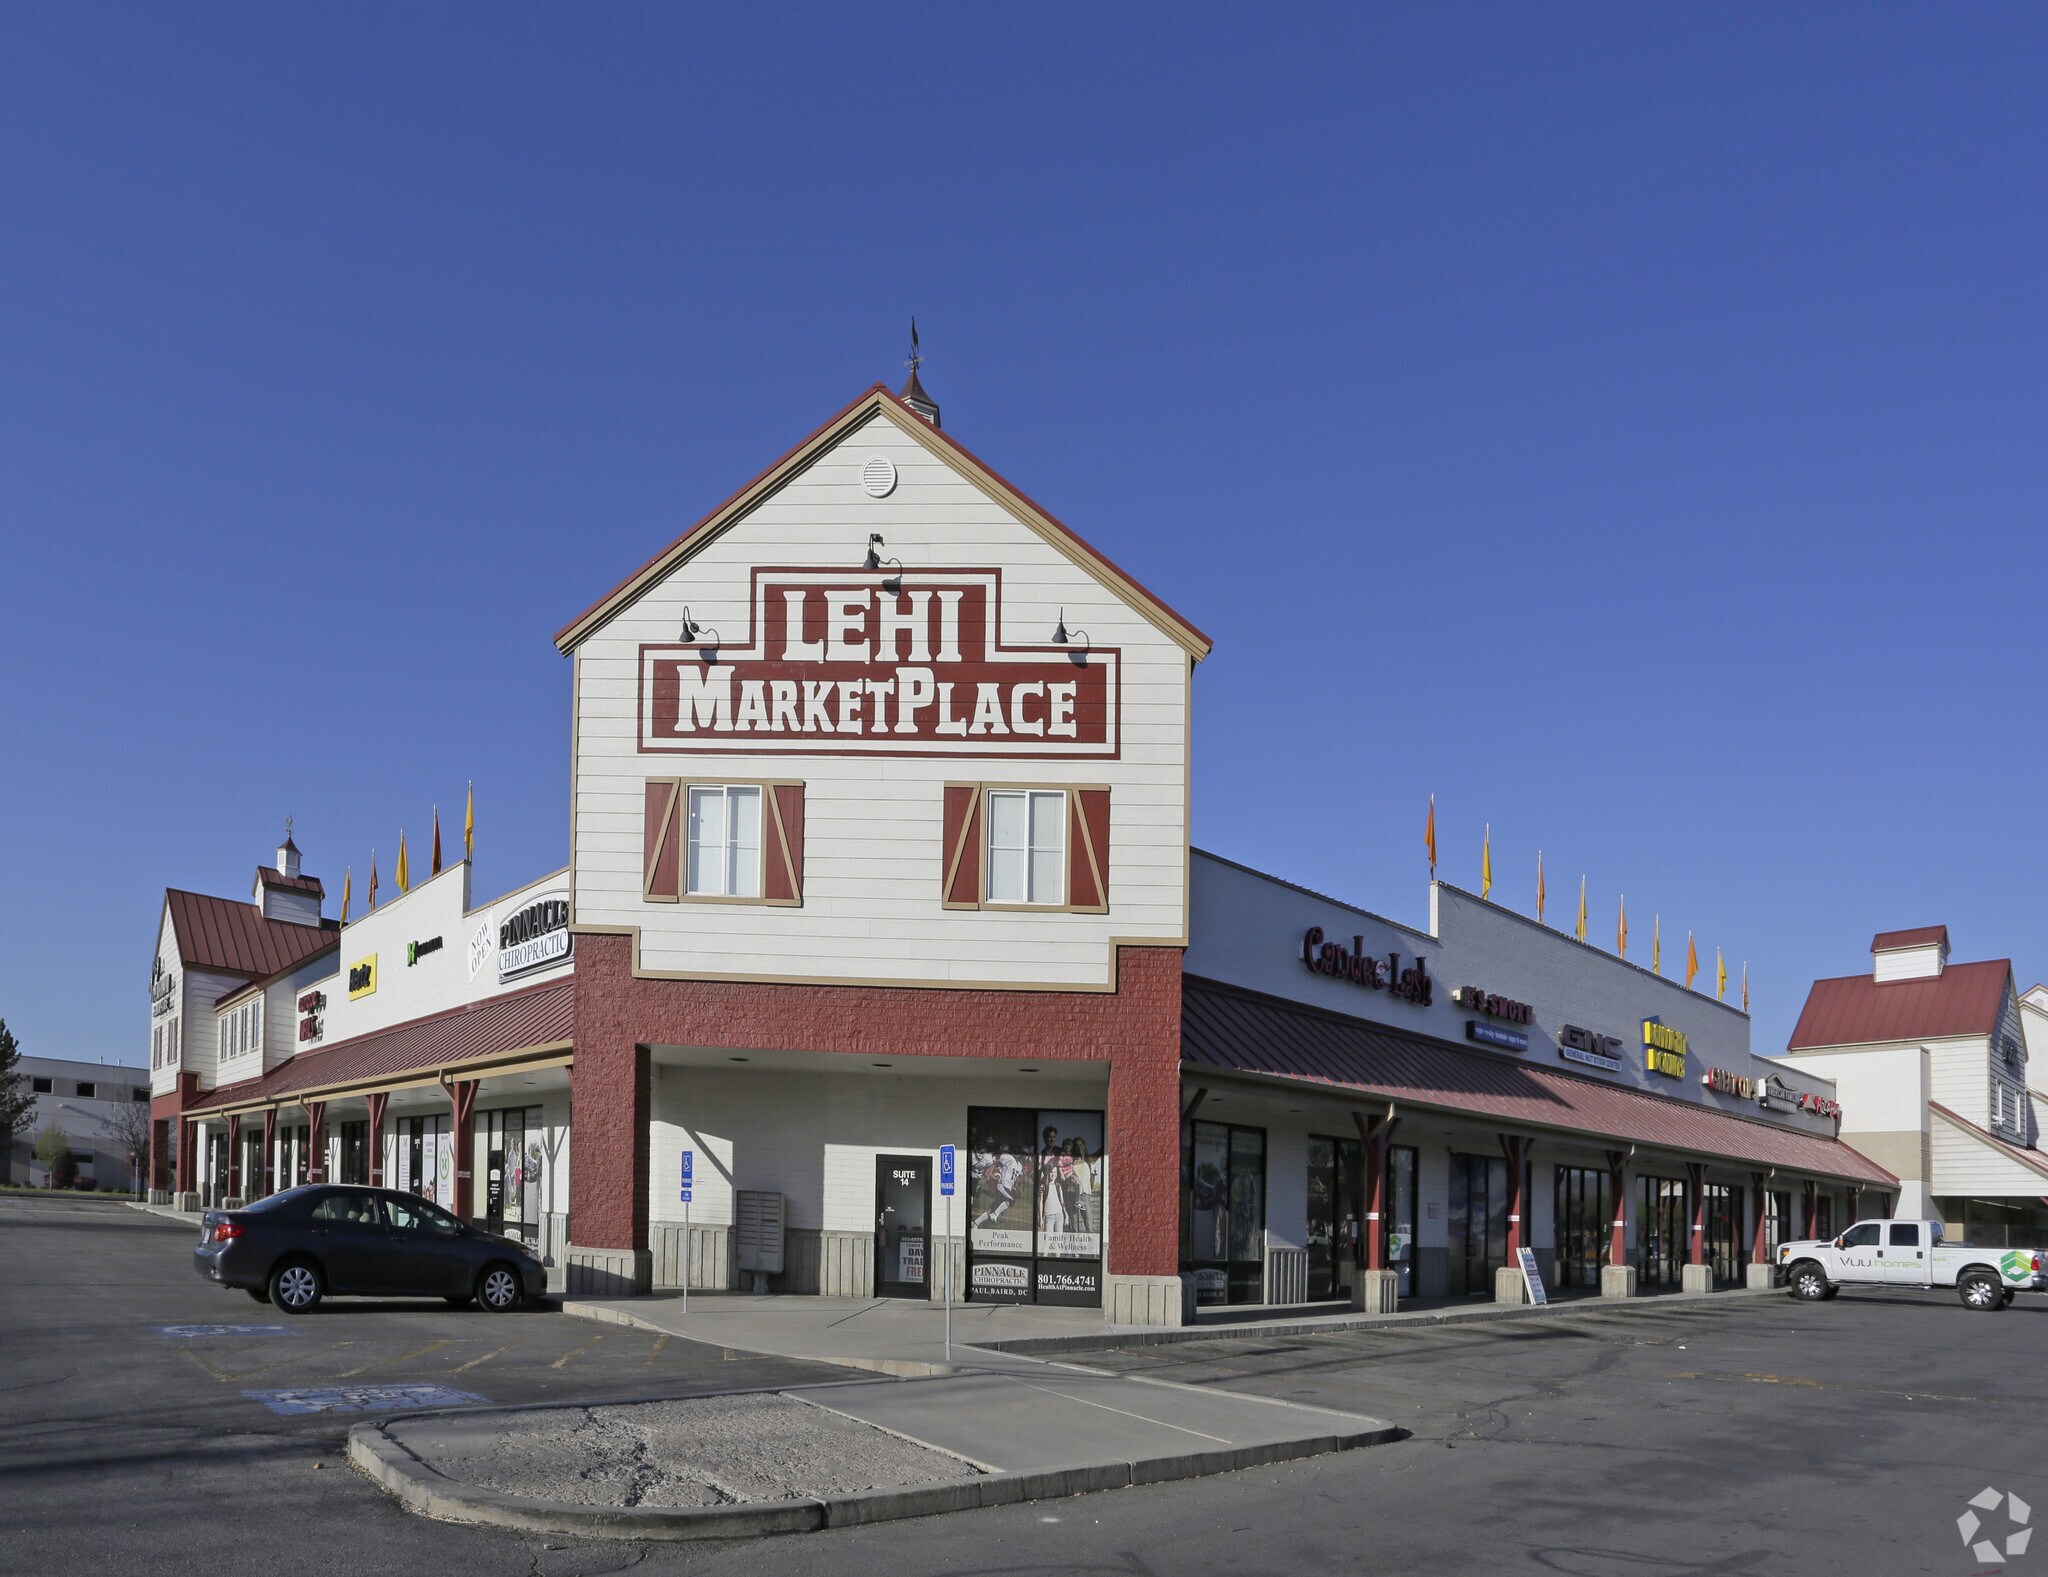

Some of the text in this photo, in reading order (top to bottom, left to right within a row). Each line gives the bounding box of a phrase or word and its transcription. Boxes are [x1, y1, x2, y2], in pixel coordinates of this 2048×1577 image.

[781, 588, 964, 665] LEHI
[500, 899, 570, 950] PINNACLE
[471, 922, 488, 949] NOW
[471, 938, 492, 973] OPEN
[499, 931, 567, 971] CHIROPRACTIC
[1388, 952, 1433, 1007] Lash
[1487, 993, 1533, 1025] SMOKE
[1562, 1023, 1622, 1060] GNC
[892, 1170, 916, 1178] SUITE
[978, 1240, 1023, 1249] Performance
[1043, 1234, 1093, 1243] Family Health
[974, 1266, 1025, 1278] PINNACLE
[1874, 1260, 1922, 1269] homes
[974, 1276, 1024, 1285] CHIROPRACTIC
[1038, 1274, 1095, 1286] 801.766.4741
[1038, 1284, 1096, 1292] HealthAtPinnacle.com
